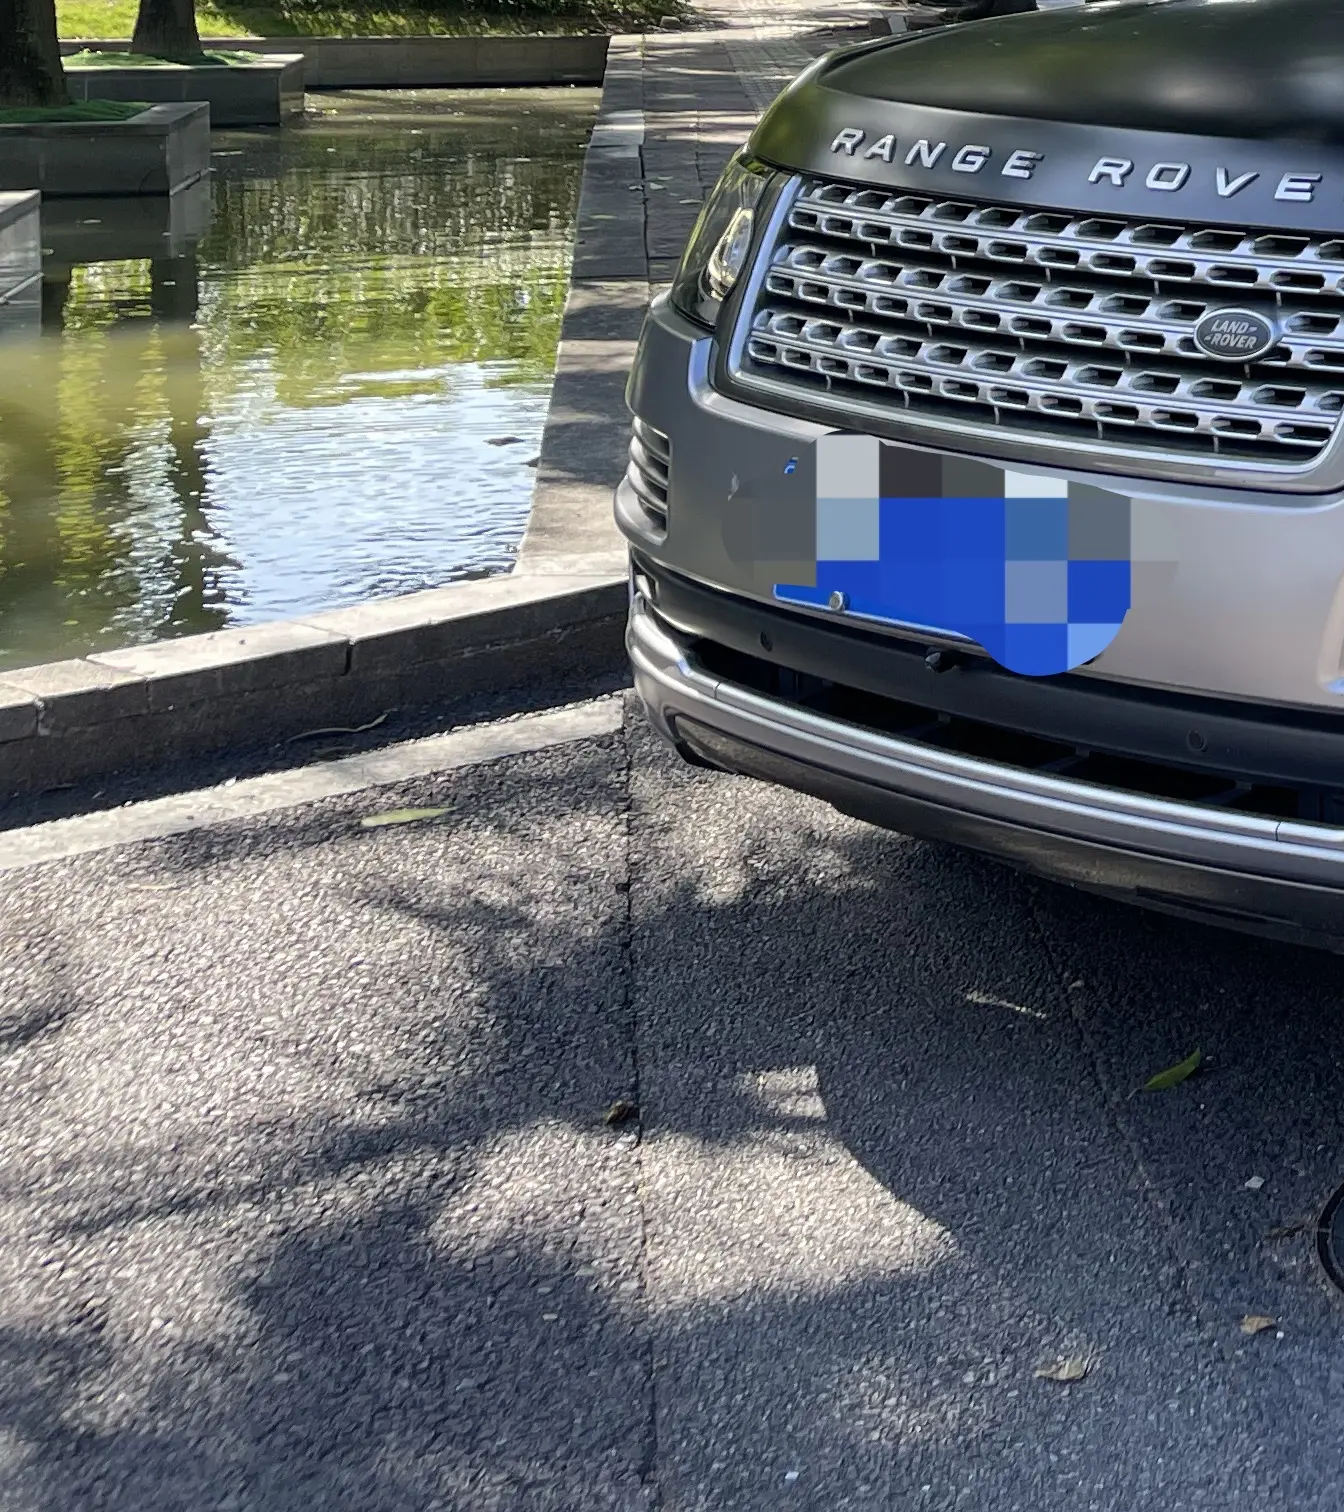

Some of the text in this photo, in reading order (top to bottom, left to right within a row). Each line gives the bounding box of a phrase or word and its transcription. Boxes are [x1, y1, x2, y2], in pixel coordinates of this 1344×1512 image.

[830, 126, 1045, 181] RANGE
[1210, 319, 1258, 350] LAND ROVER
